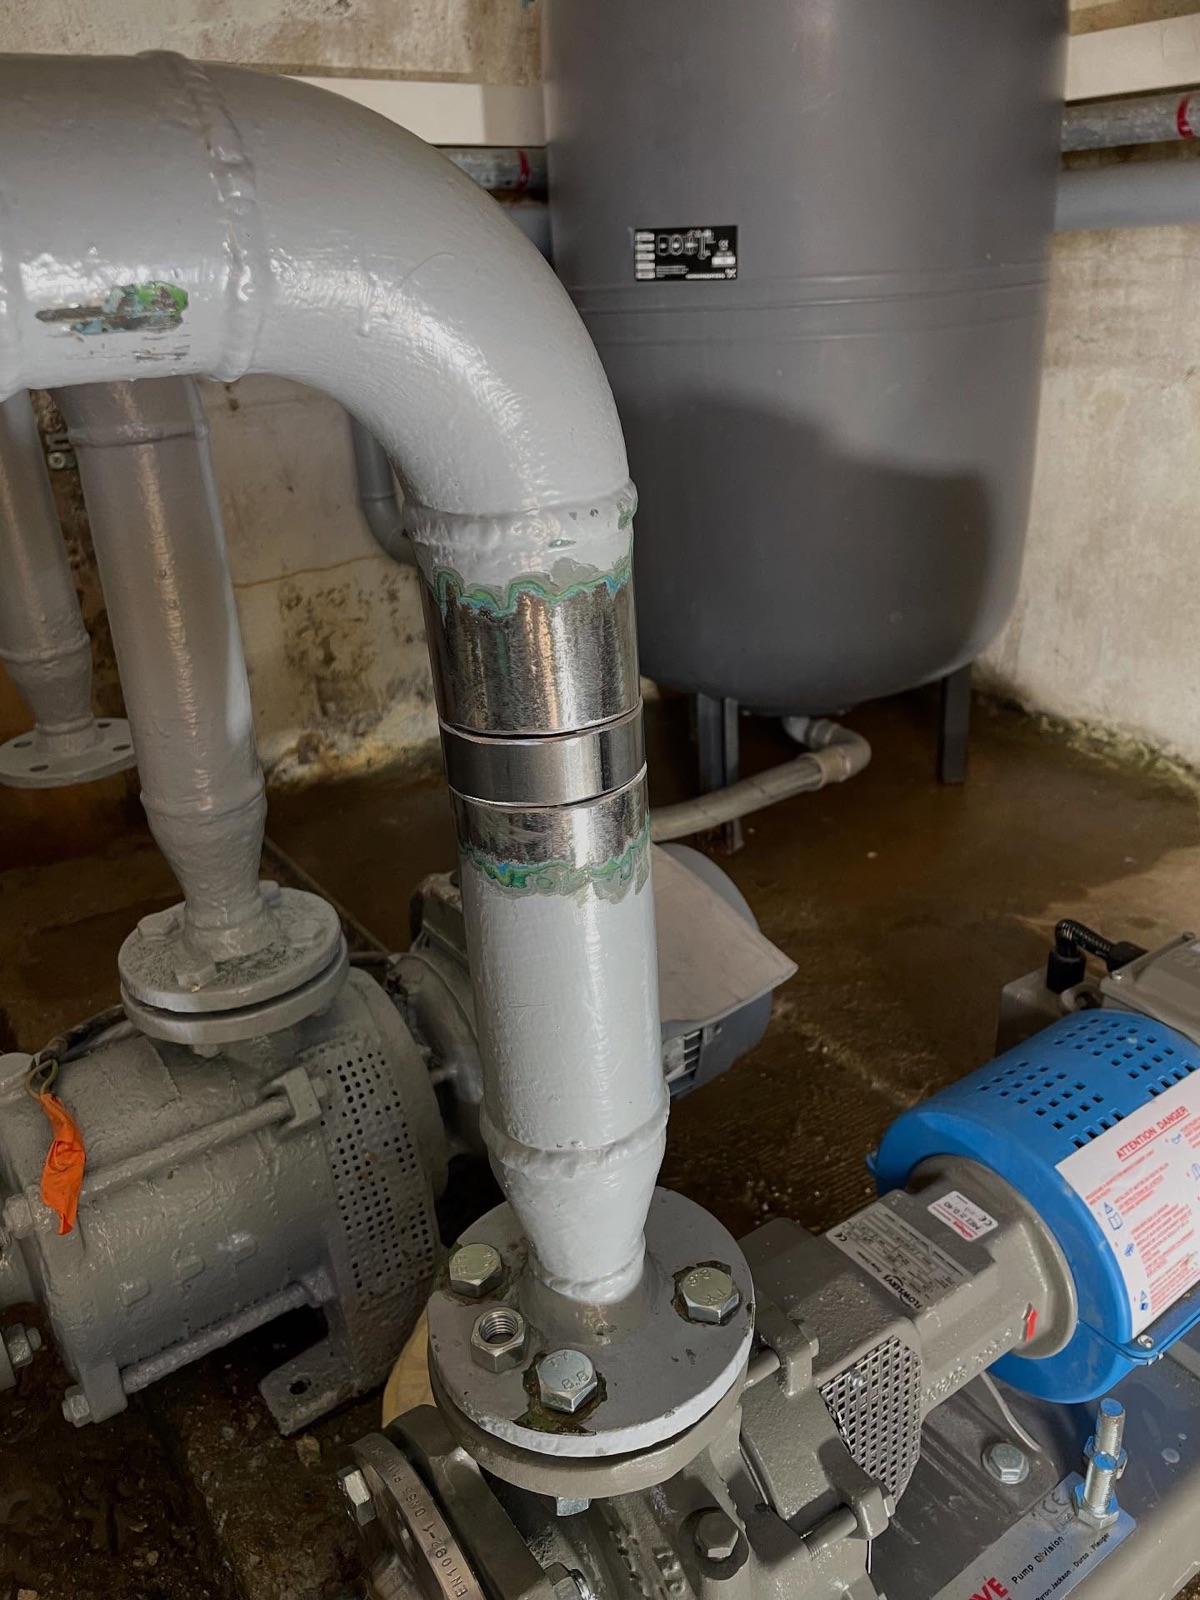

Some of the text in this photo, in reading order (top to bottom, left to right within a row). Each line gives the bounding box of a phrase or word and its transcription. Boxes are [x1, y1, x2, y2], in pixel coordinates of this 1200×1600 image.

[1116, 1127, 1157, 1159] ATTENTION
[1156, 1105, 1190, 1131] DANGER
[1011, 1563, 1035, 1585] Pump
[1034, 1535, 1065, 1563] Division
[1051, 1570, 1072, 1591] Jackson
[1073, 1552, 1090, 1568] Durco
